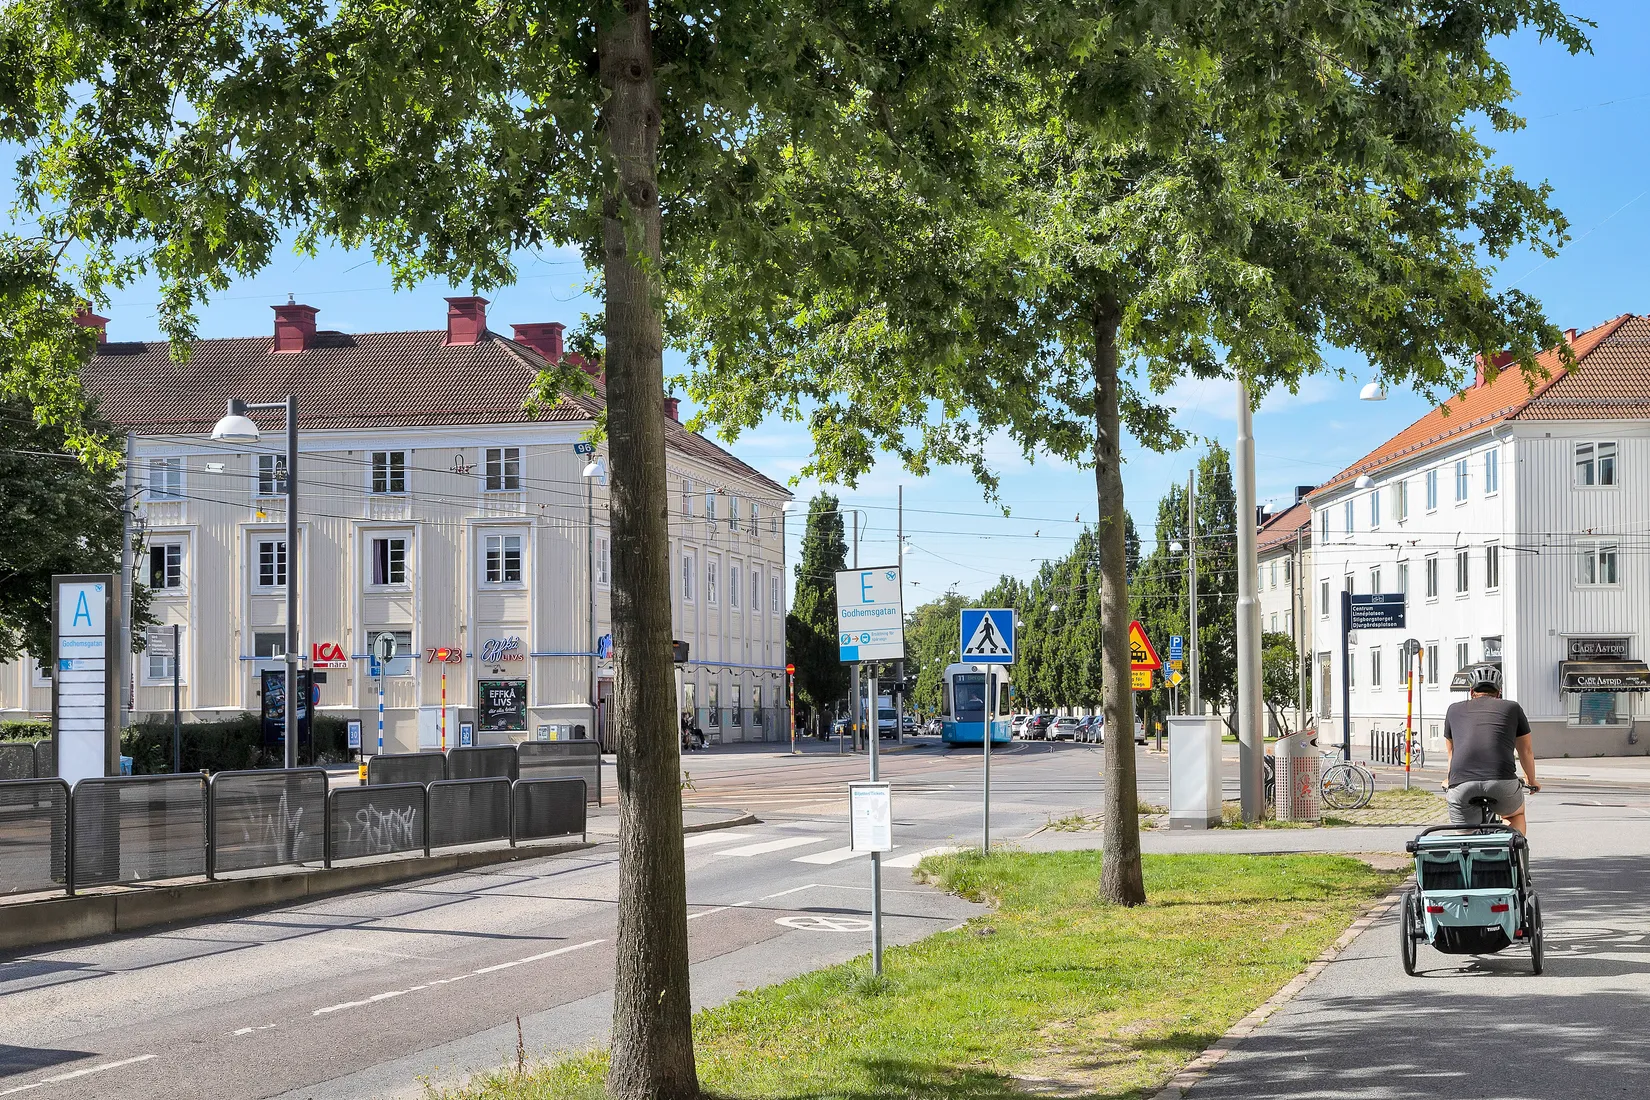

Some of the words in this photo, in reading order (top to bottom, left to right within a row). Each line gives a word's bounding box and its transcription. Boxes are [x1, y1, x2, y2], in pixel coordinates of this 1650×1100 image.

[578, 444, 591, 452] 96
[861, 572, 874, 603] E
[73, 590, 92, 627] A
[842, 607, 896, 618] Godhemsgatan
[62, 640, 103, 648] Godhemsgatan
[1173, 637, 1181, 647] P
[313, 643, 347, 661] ICA
[502, 653, 524, 661] LIVS
[67, 661, 73, 670] 3
[489, 687, 517, 698] EFFKÅ
[493, 698, 512, 706] LIVS
